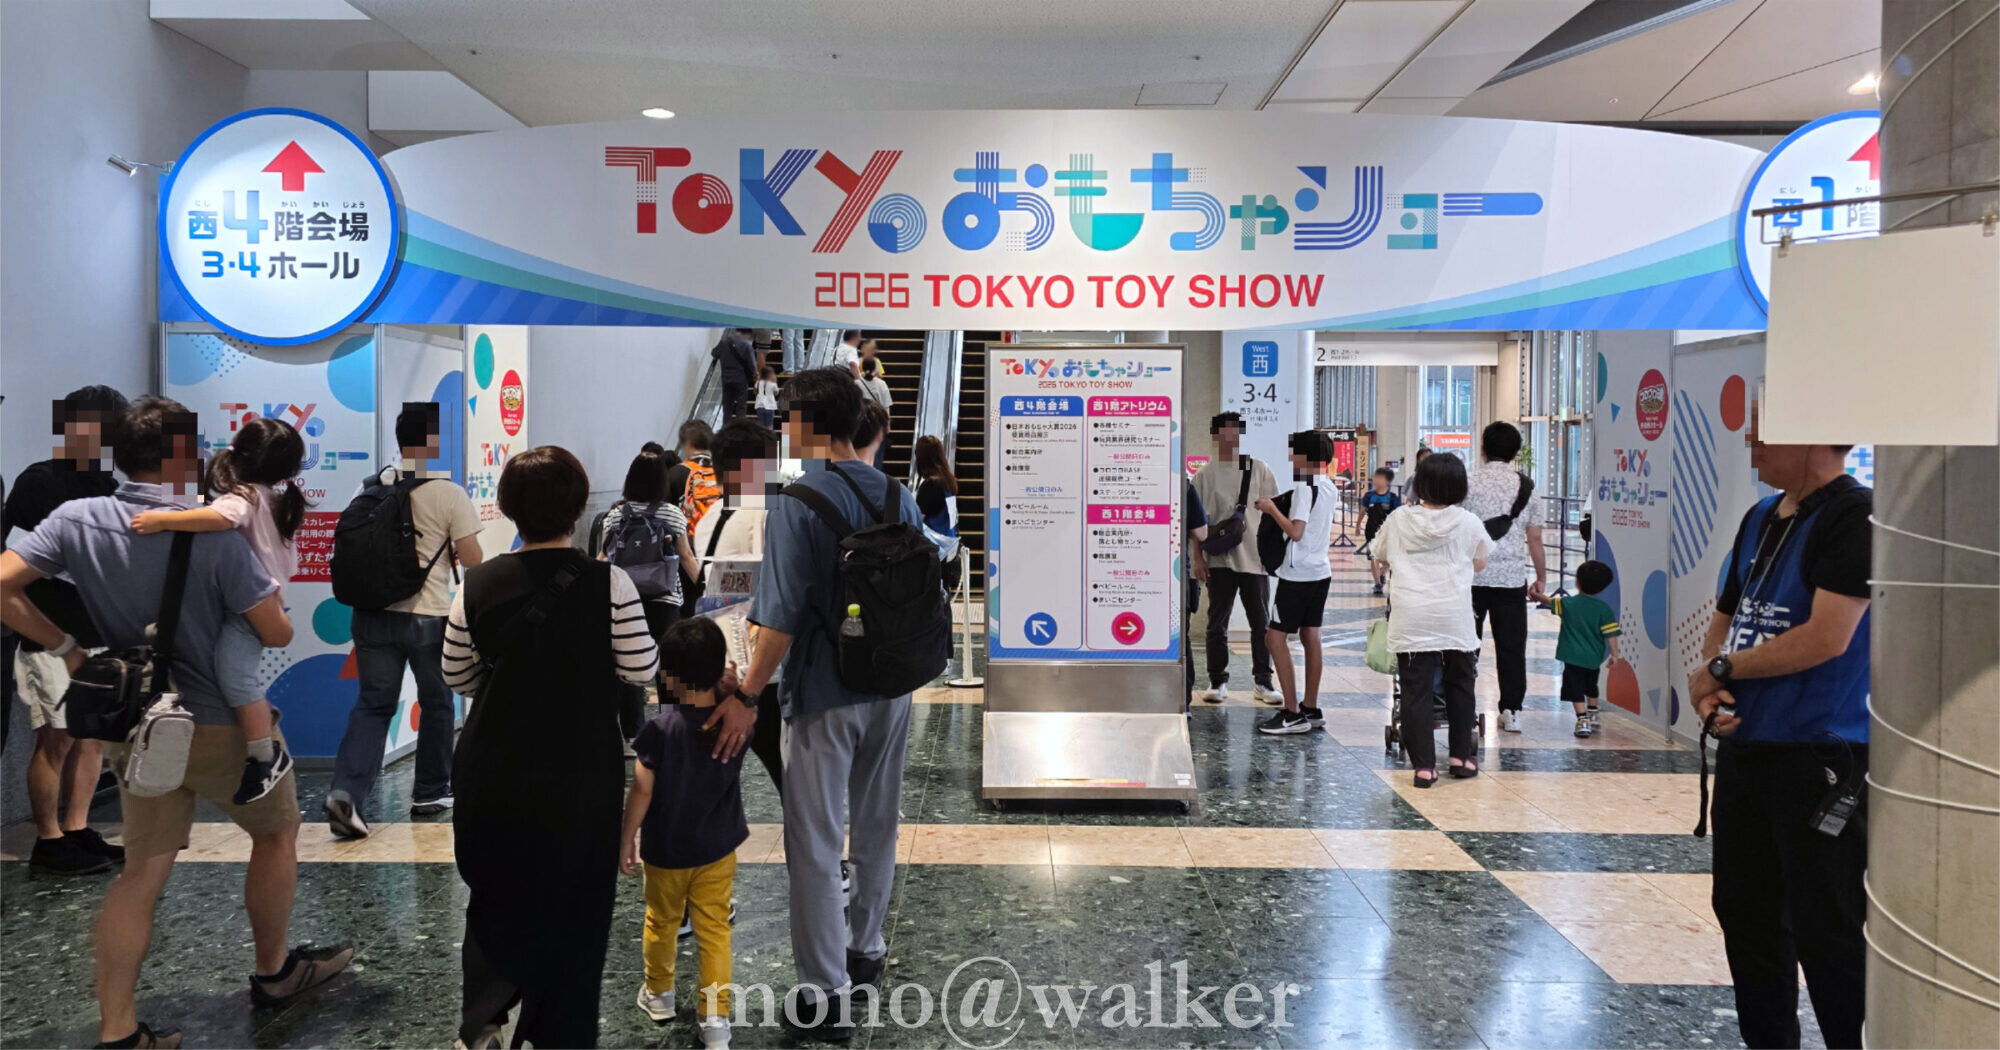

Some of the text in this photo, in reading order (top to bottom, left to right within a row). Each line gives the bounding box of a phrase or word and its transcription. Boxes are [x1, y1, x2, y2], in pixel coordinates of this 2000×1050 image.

[942, 152, 1543, 251] おもちゃショー
[188, 190, 369, 244] 西4階会場
[815, 272, 1325, 308] 2026 TOKYO TOY SHOW
[1251, 345, 1269, 353] West
[1316, 347, 1326, 362] 2
[1062, 359, 1172, 378] おもちゃショー
[1252, 354, 1269, 374] 西
[1058, 381, 1087, 389] TOKYO
[1089, 381, 1107, 389] TOY
[1108, 381, 1133, 389] SHOW
